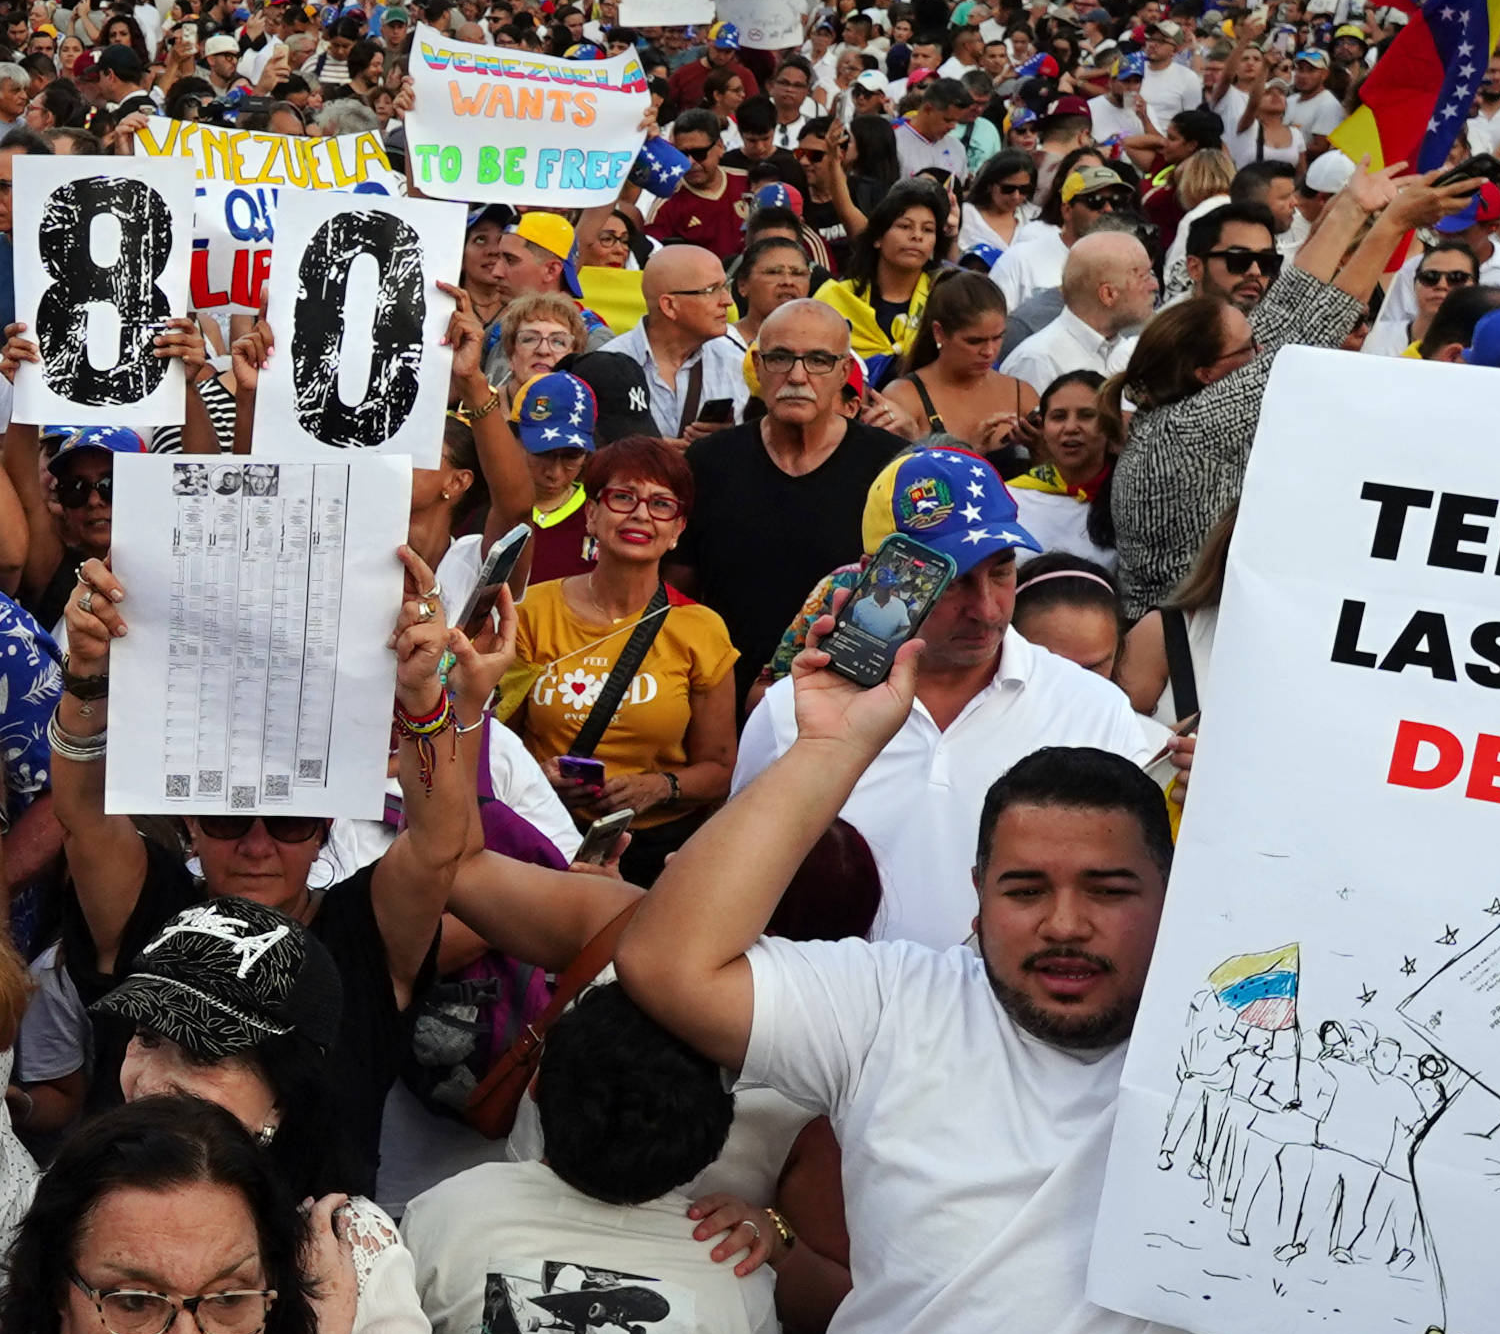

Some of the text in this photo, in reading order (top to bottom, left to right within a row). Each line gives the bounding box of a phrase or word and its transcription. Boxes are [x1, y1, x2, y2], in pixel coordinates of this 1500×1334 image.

[420, 41, 649, 94] VENEZUELA
[448, 80, 597, 127] WANTS
[135, 119, 392, 189] VENEZUELA
[414, 145, 632, 190] TO BE FREE
[35, 175, 174, 408] 8
[292, 209, 426, 448] 0
